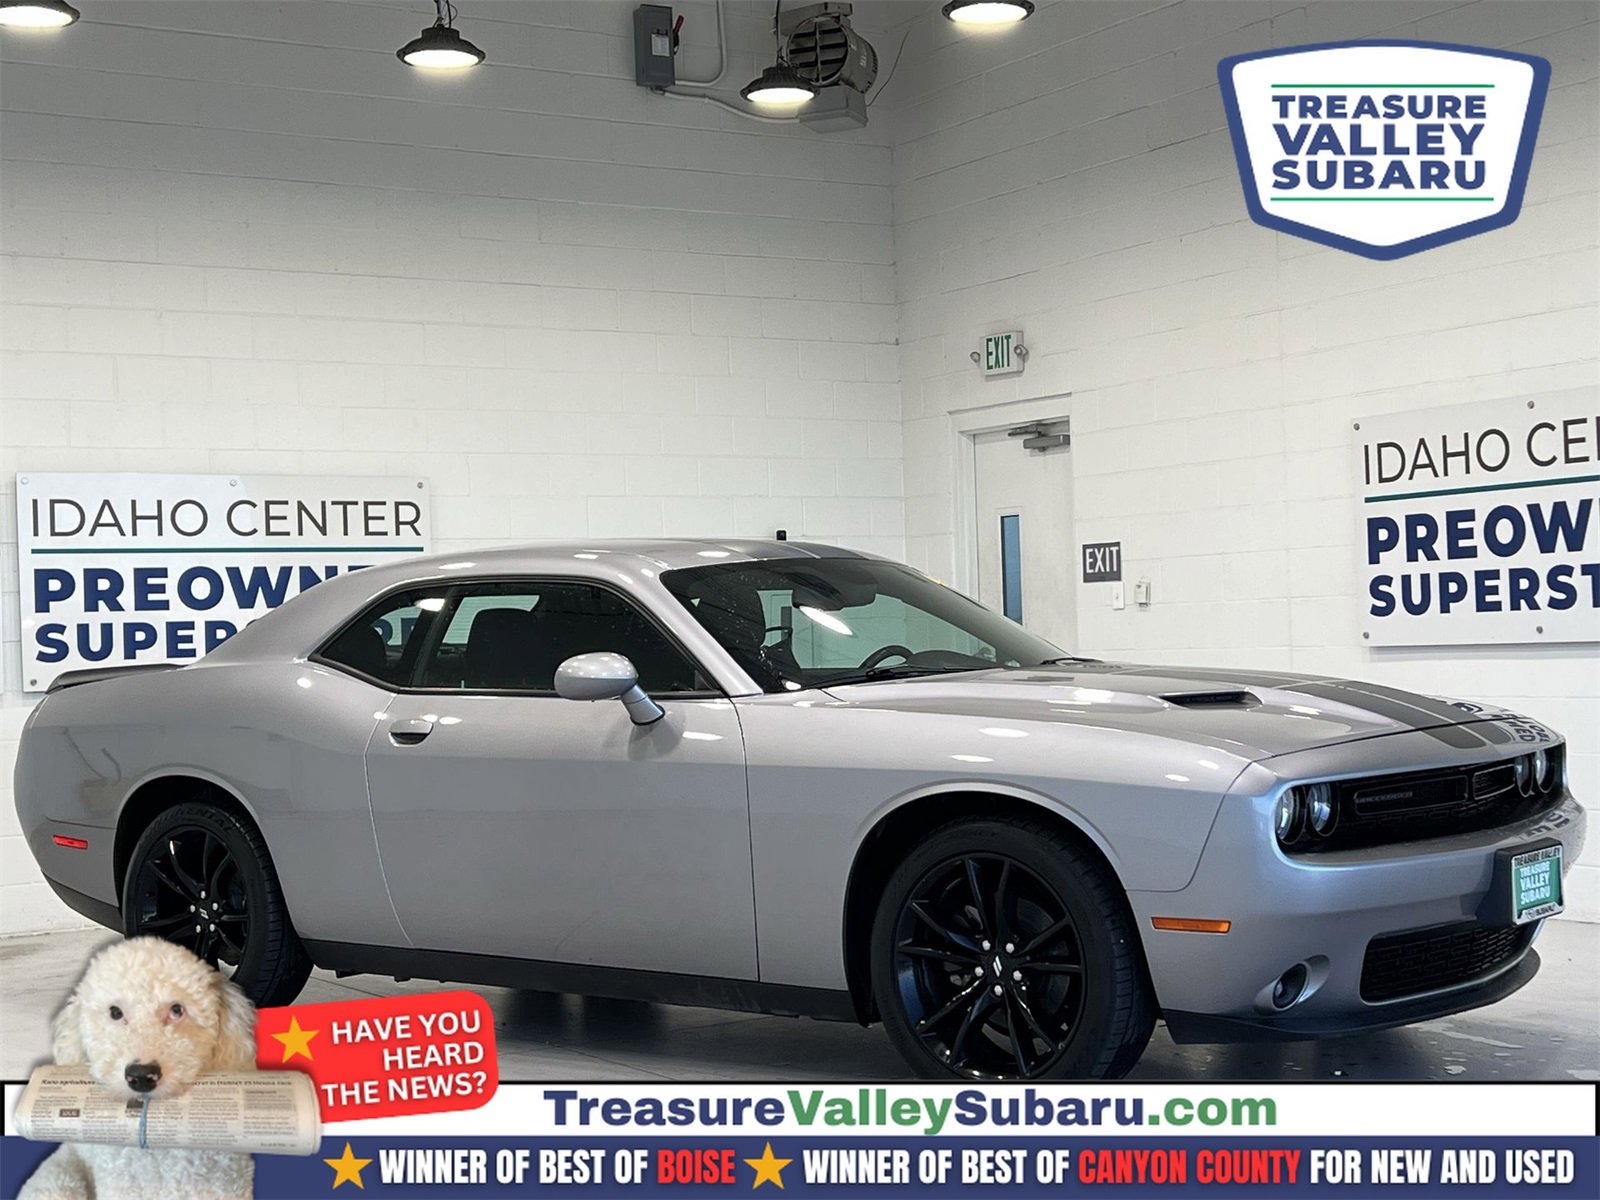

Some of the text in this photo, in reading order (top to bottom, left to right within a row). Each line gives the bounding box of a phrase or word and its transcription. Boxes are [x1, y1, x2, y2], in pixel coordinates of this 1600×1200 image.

[986, 334, 1012, 370] EXIT
[1363, 415, 1600, 485] IDAHO CE
[31, 499, 422, 537] IDAHO CENTER
[1366, 497, 1600, 565] PREOW
[1085, 545, 1119, 574] EXIT
[1514, 851, 1540, 867] TREASURE
[1520, 861, 1550, 877] TREASURE
[1520, 872, 1550, 891] VALLEY
[1520, 885, 1550, 905] SUBARU
